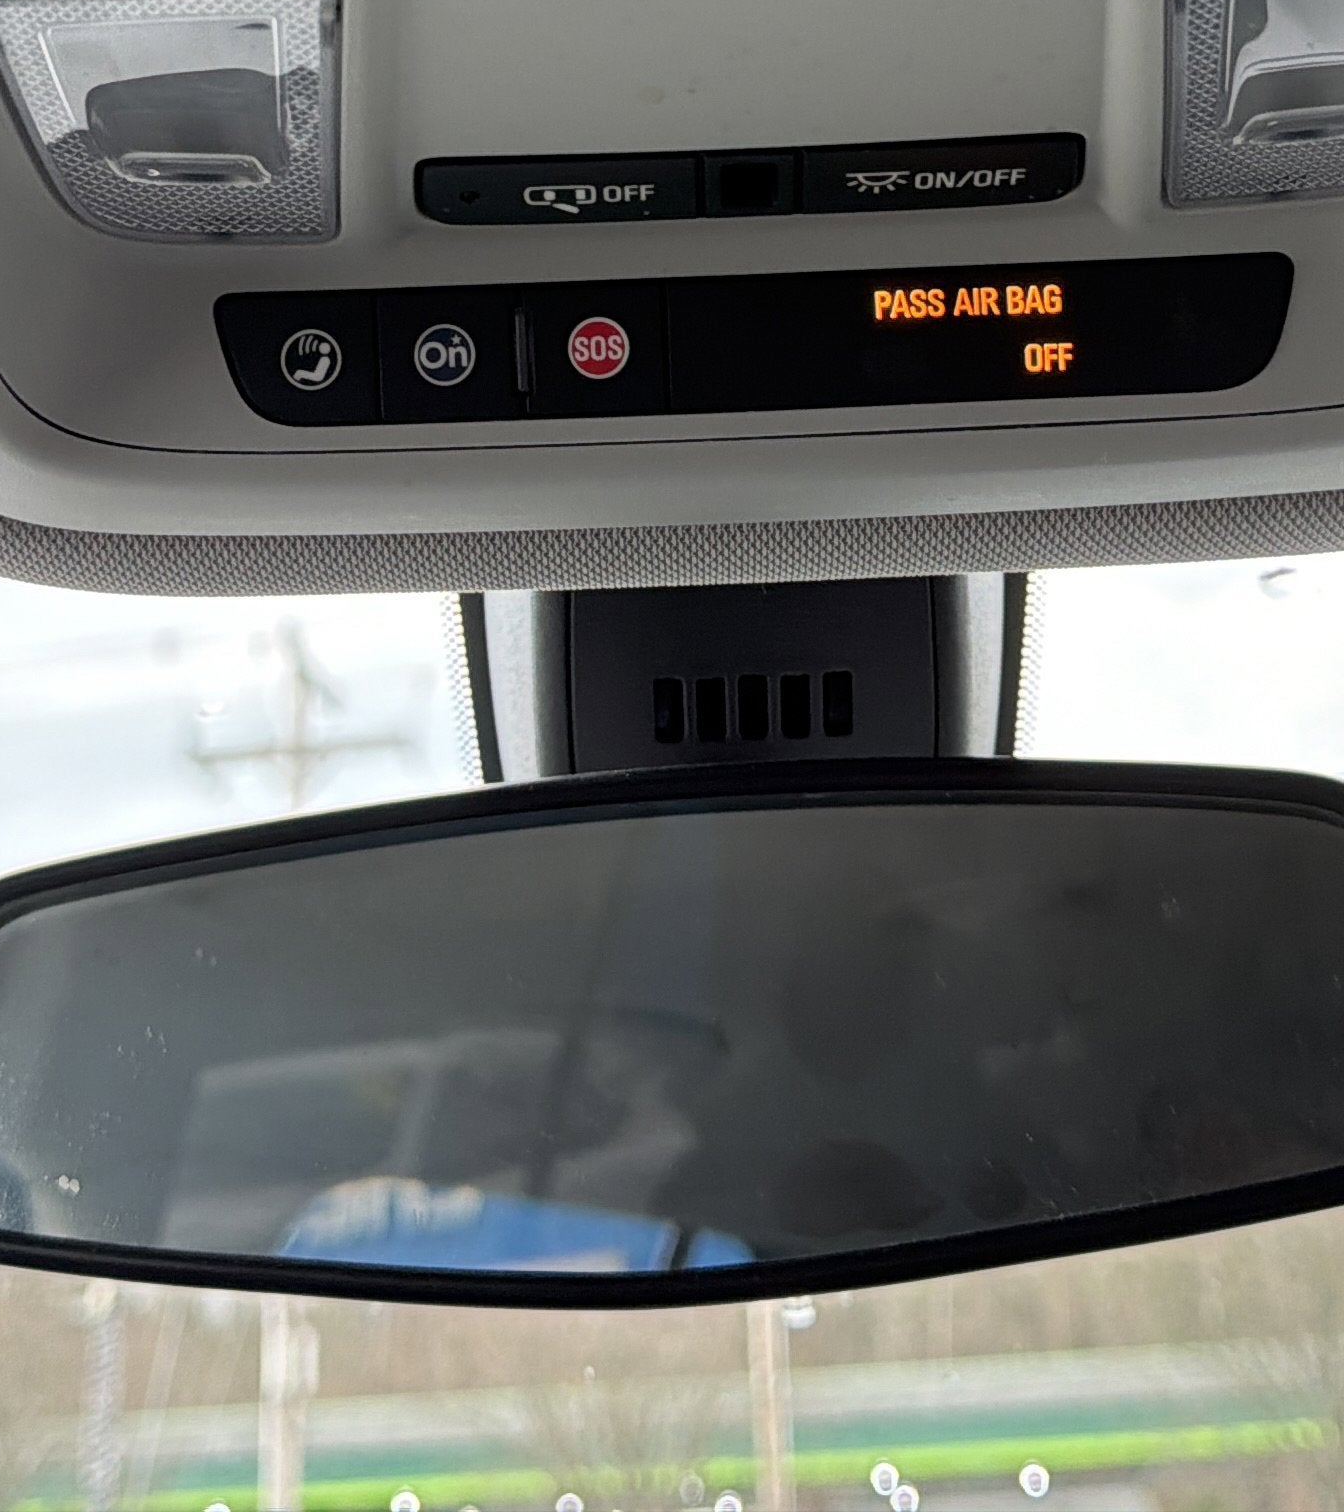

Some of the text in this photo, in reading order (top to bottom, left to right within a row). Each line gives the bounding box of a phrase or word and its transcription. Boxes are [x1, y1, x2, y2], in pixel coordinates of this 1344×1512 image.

[602, 183, 655, 203] OFF
[913, 167, 1027, 191] ON/OFF
[873, 283, 1063, 321] PASS AIR BAG
[418, 343, 468, 371] On
[573, 334, 623, 364] SOS
[1023, 342, 1074, 373] OFF
